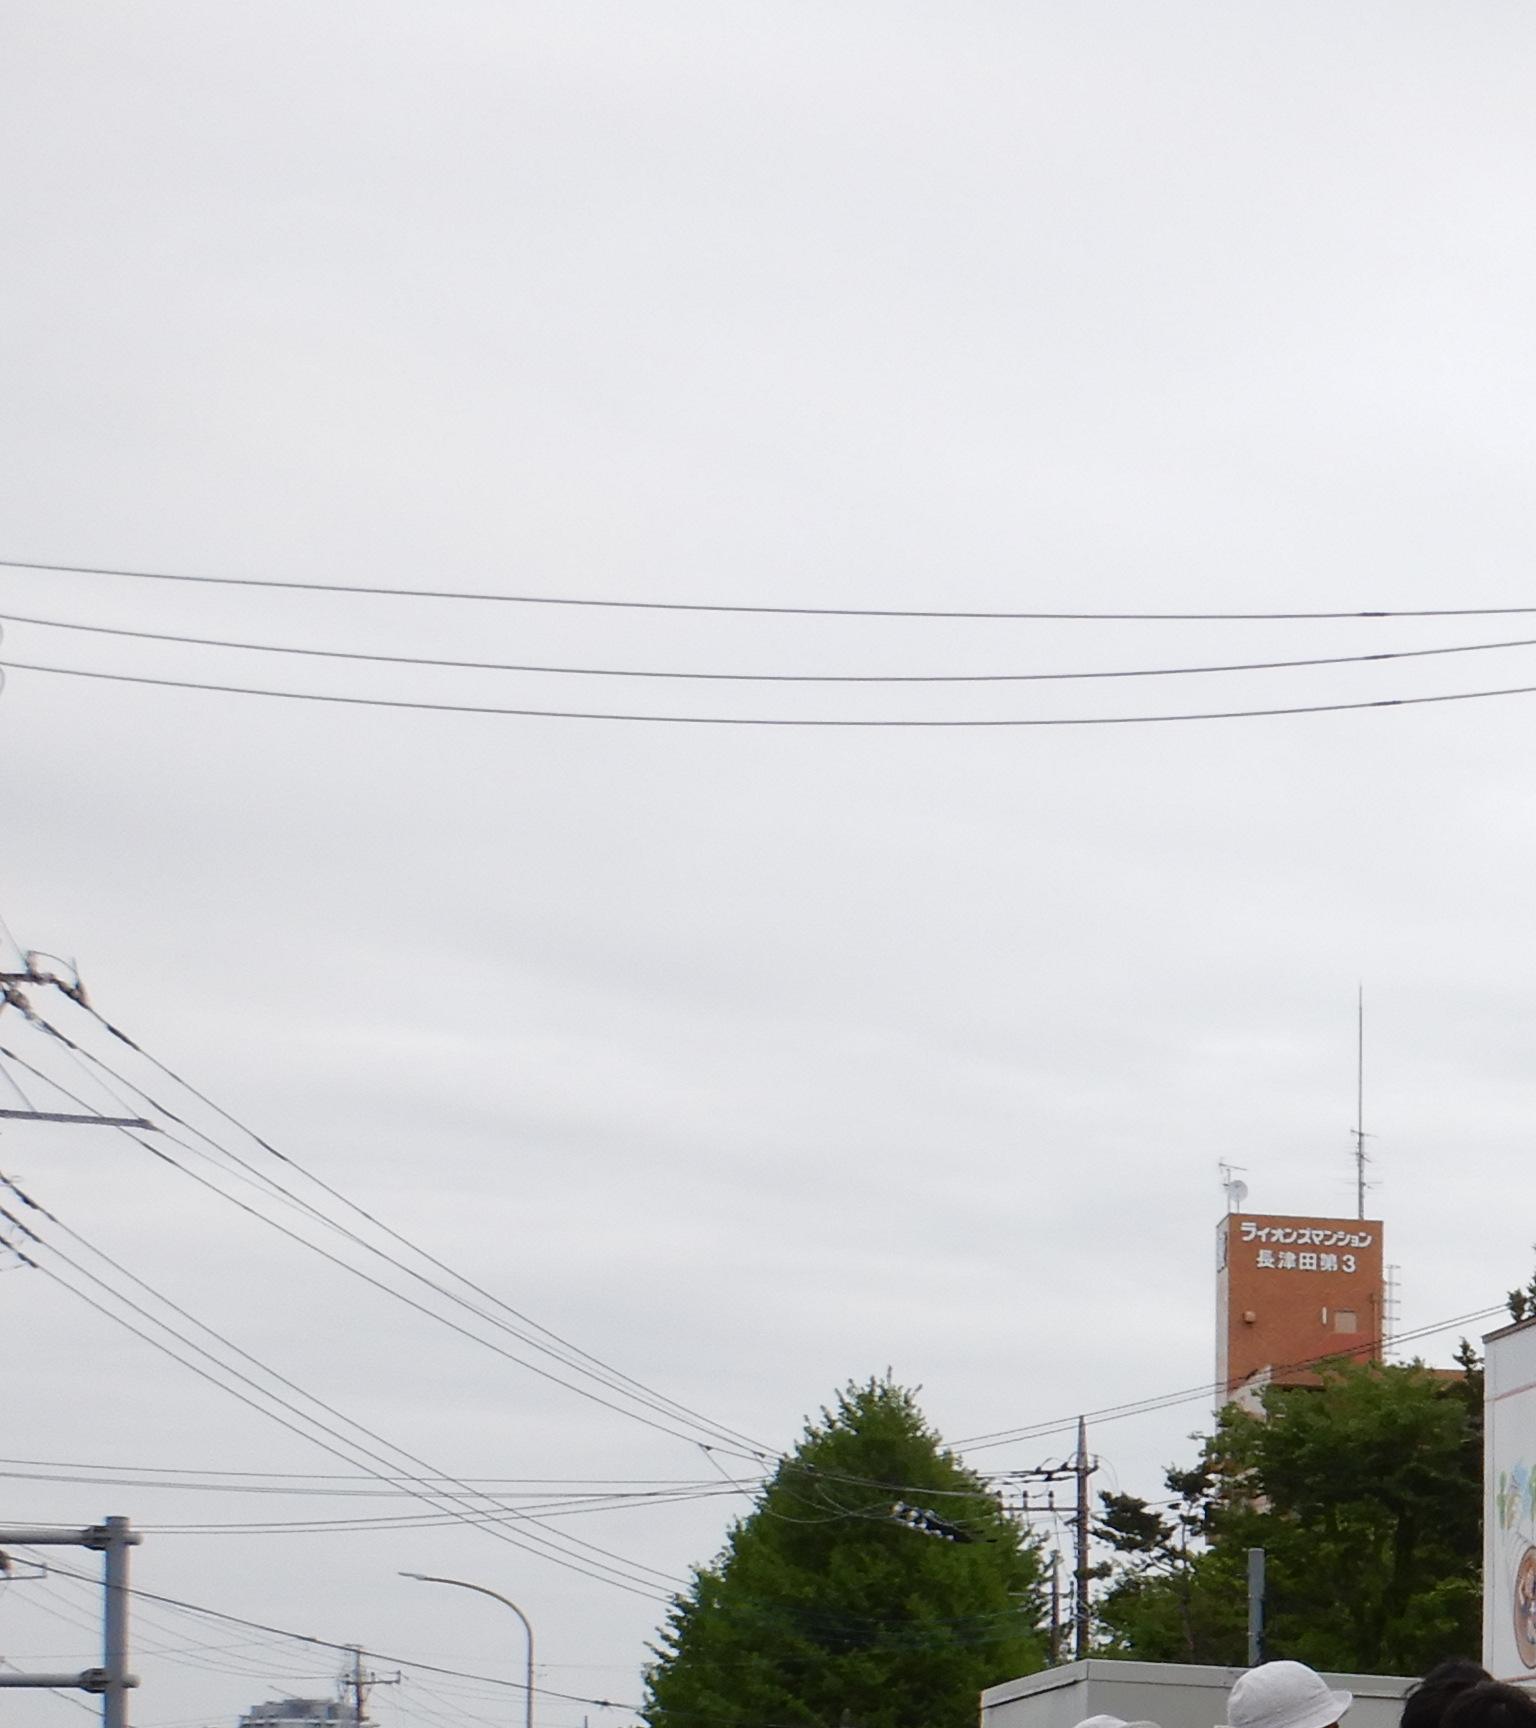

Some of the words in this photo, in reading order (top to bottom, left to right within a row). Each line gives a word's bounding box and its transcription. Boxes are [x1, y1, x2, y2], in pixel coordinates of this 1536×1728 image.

[1240, 1221, 1372, 1248] ライオンズマンション
[1256, 1248, 1356, 1273] 長津田第3
